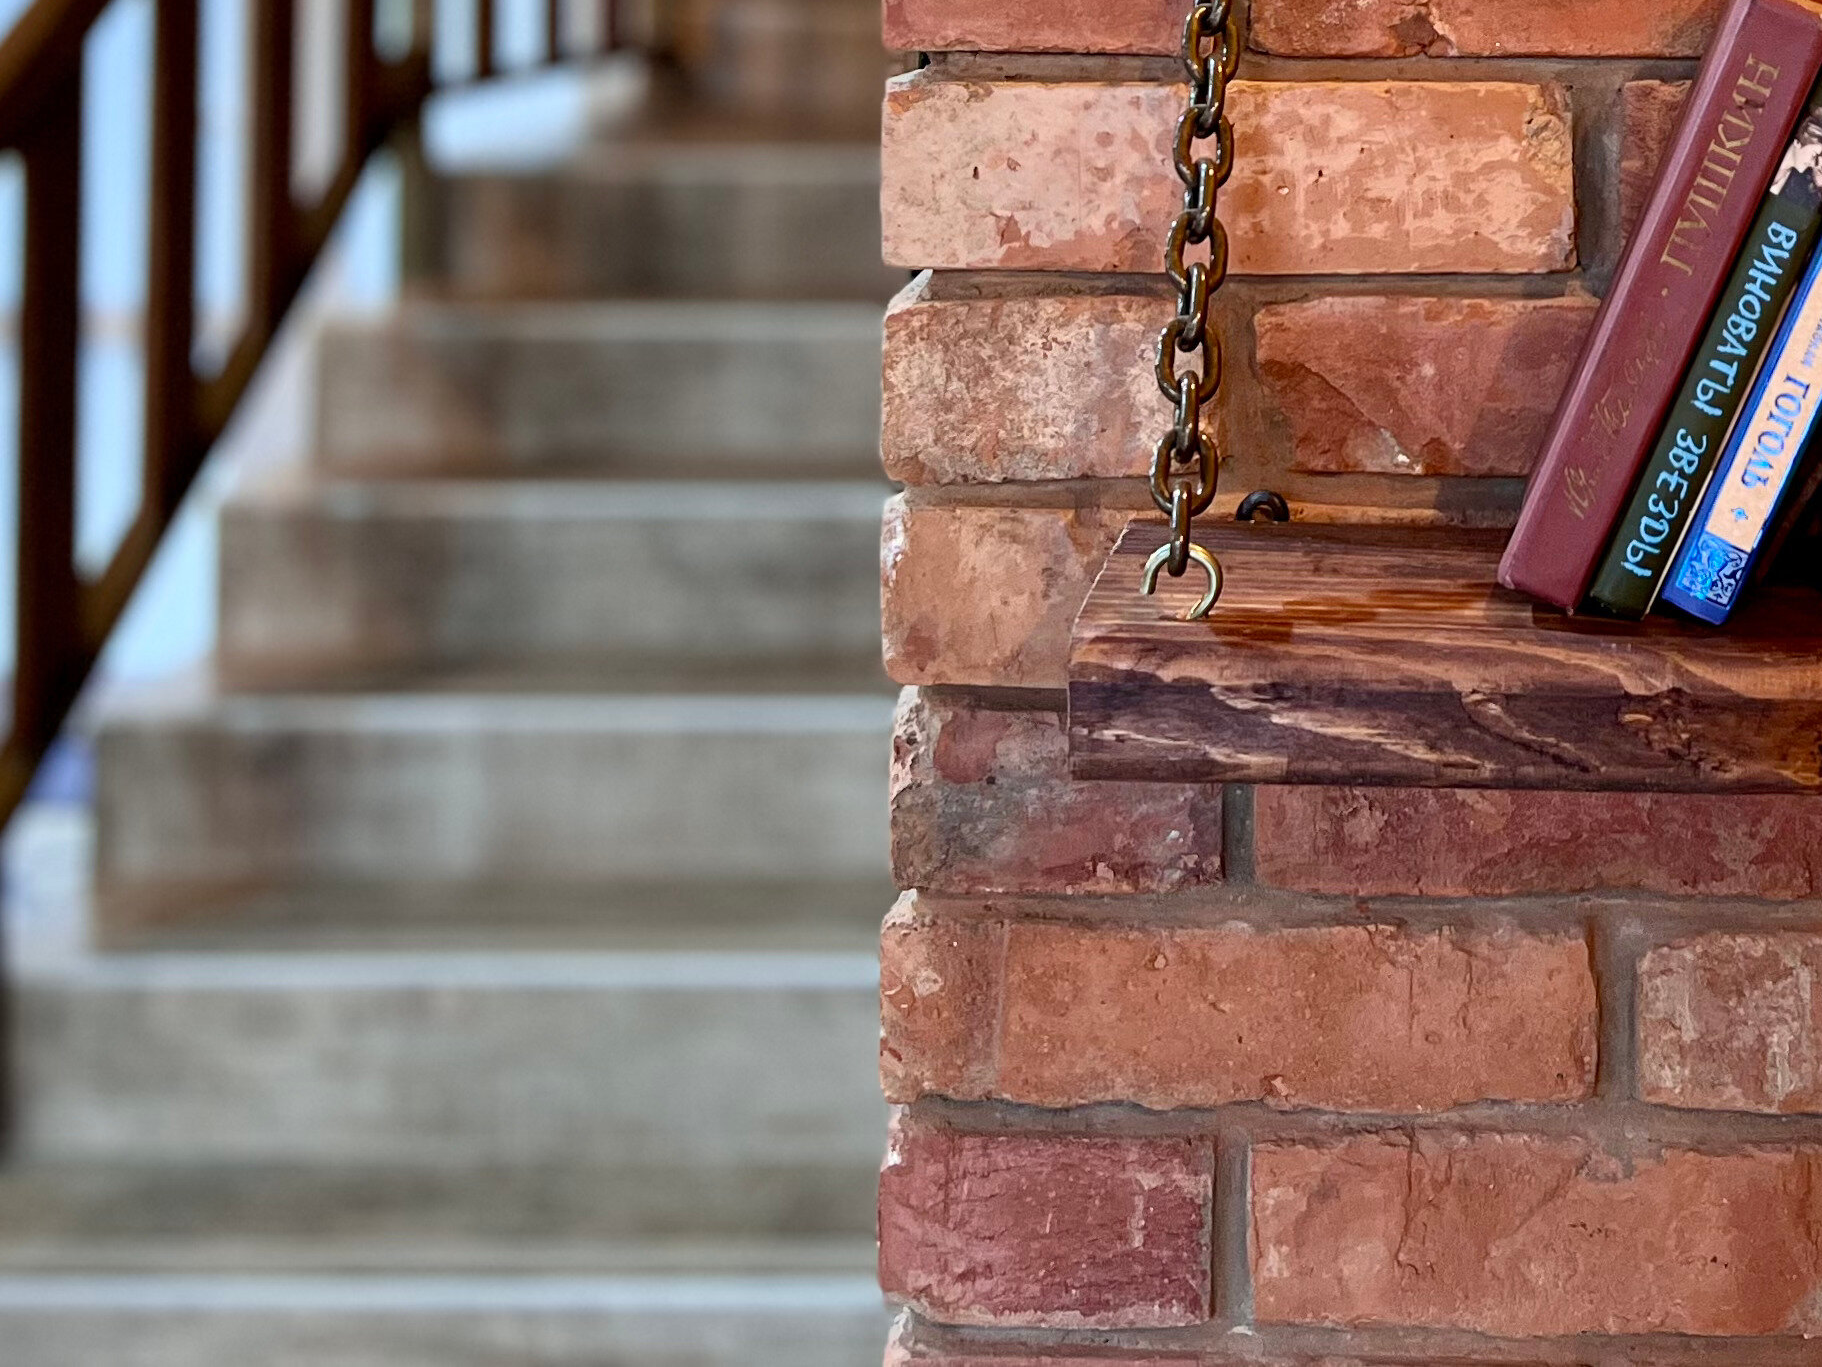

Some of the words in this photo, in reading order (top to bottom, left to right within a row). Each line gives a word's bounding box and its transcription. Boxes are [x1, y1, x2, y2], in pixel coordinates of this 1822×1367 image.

[1659, 52, 1781, 277] ПУШКИН
[1690, 220, 1798, 417] ВИНОВАТЫ
[1620, 427, 1708, 577] ЗВЕЗДЫ
[1741, 373, 1812, 490] ГОГОЛЬ
